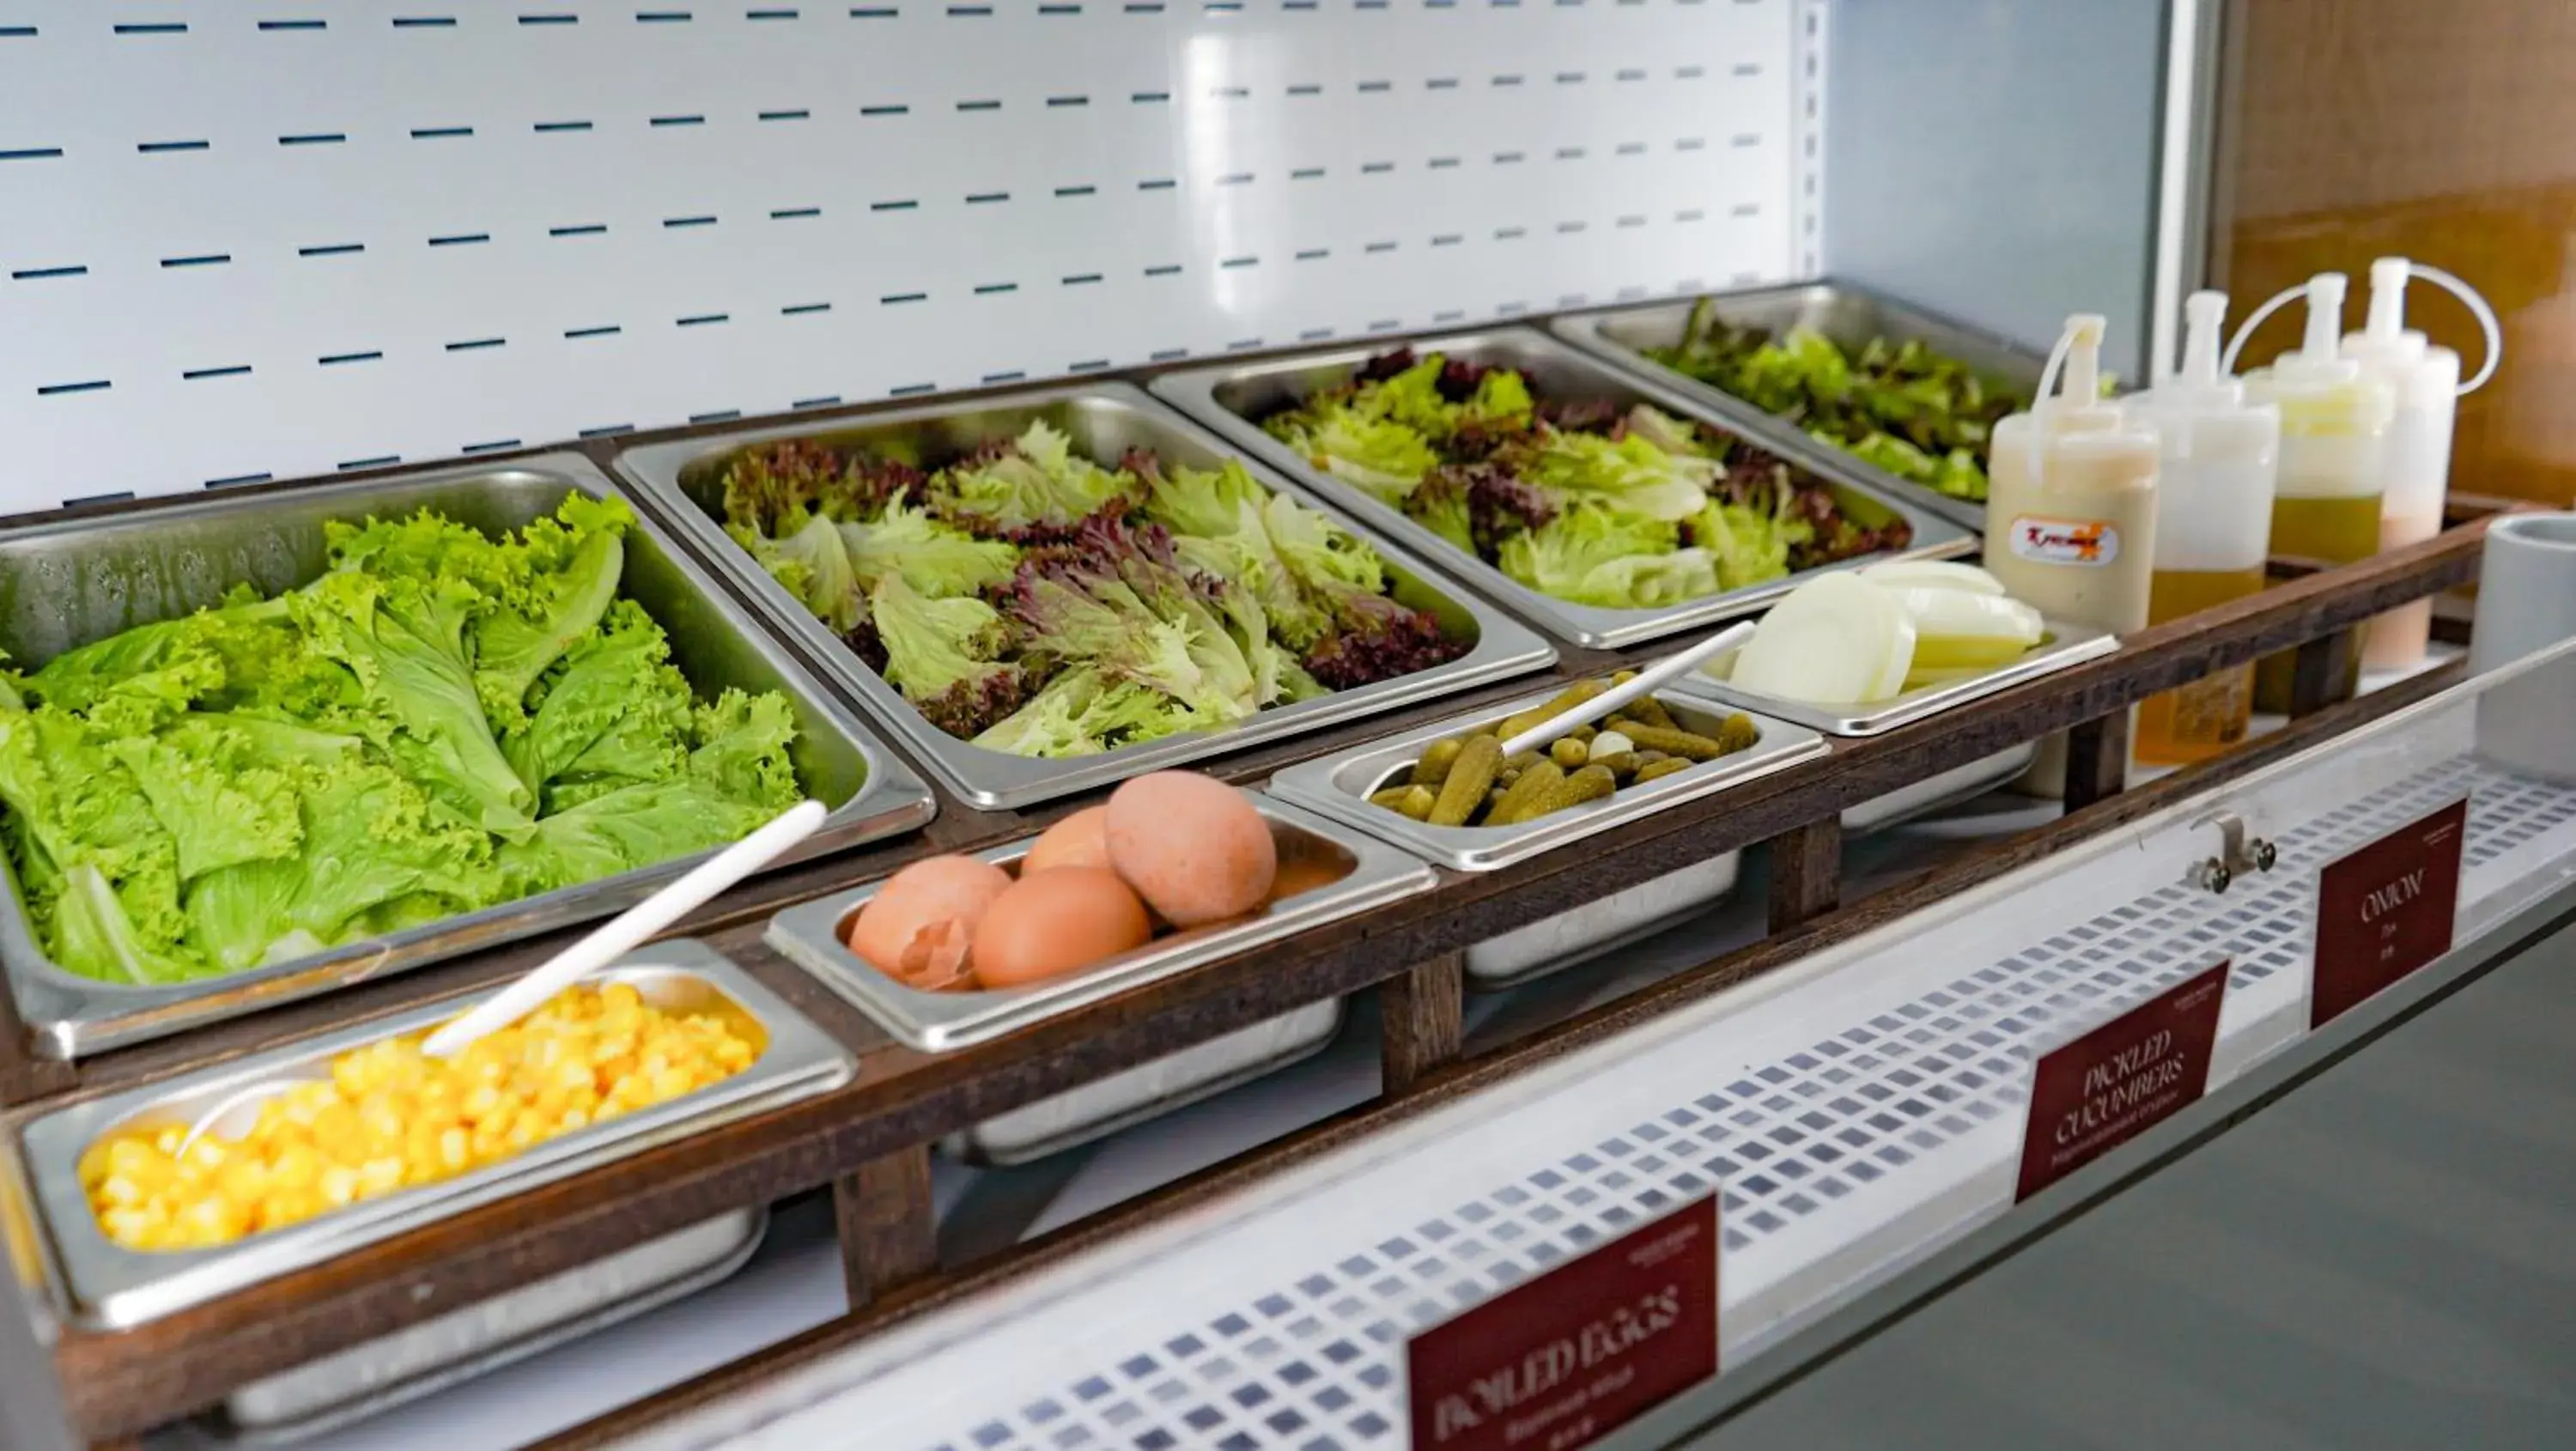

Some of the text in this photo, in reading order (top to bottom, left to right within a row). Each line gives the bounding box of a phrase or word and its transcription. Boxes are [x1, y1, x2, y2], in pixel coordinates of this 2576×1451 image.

[2361, 868, 2425, 923] ONION
[2057, 1053, 2185, 1144] CUCUMBERS
[2084, 1030, 2171, 1097] PICKLED
[1436, 1339, 1577, 1442] BOILED
[1581, 1284, 1680, 1368] EGGS
